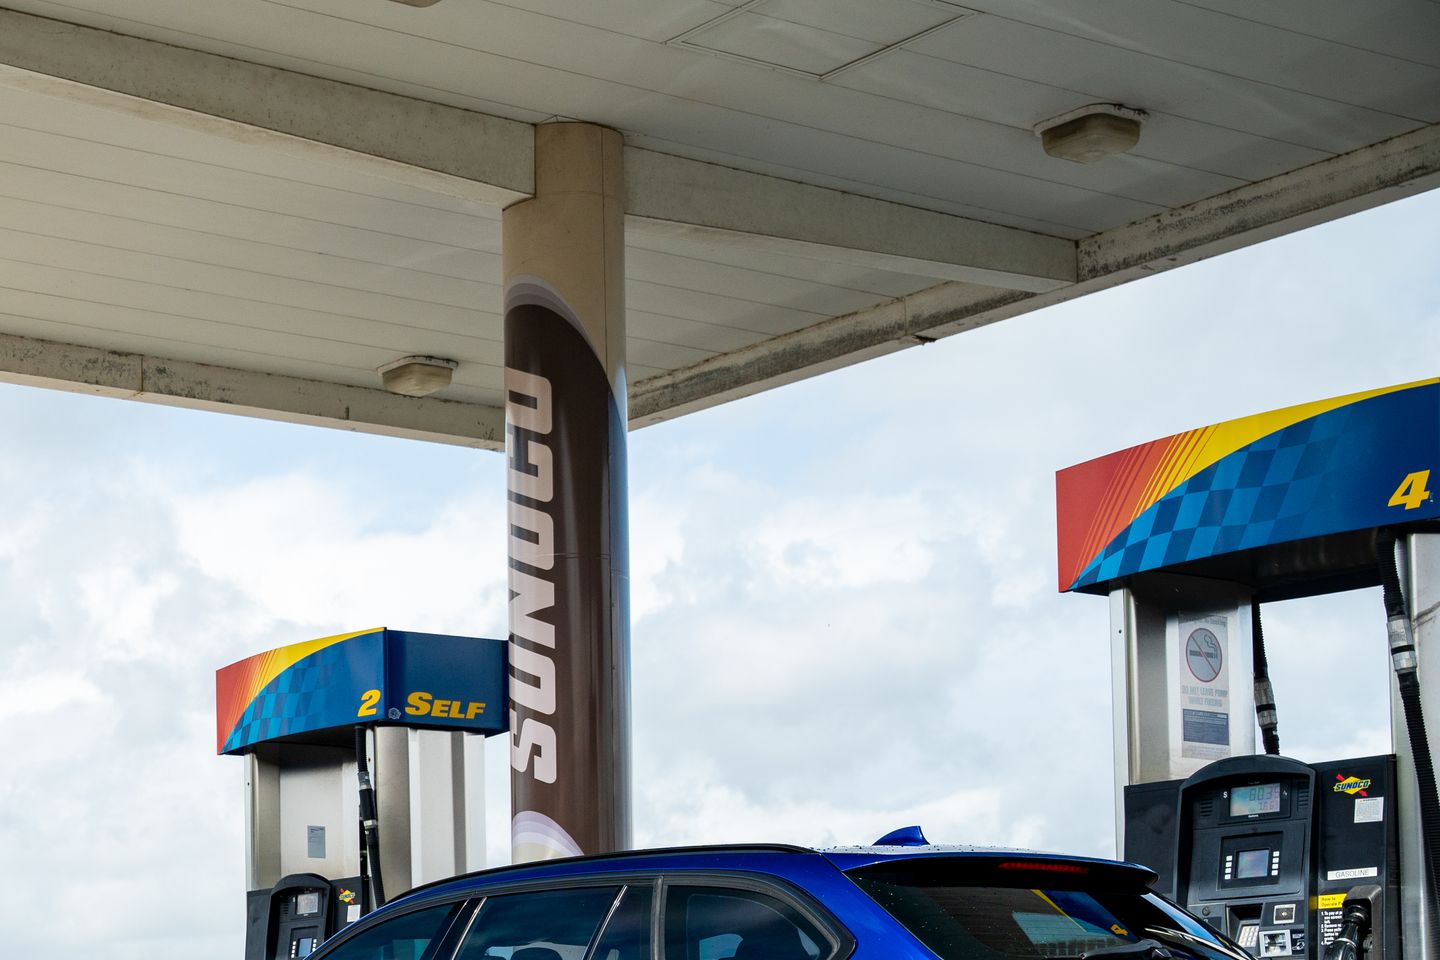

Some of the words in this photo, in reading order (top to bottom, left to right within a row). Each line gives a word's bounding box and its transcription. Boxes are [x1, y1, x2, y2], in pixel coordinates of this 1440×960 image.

[1387, 469, 1430, 510] 4
[505, 367, 557, 784] SUNOCO
[357, 689, 381, 717] 2
[1334, 779, 1371, 792] SUNOCO
[1335, 869, 1369, 878] GASOLINE
